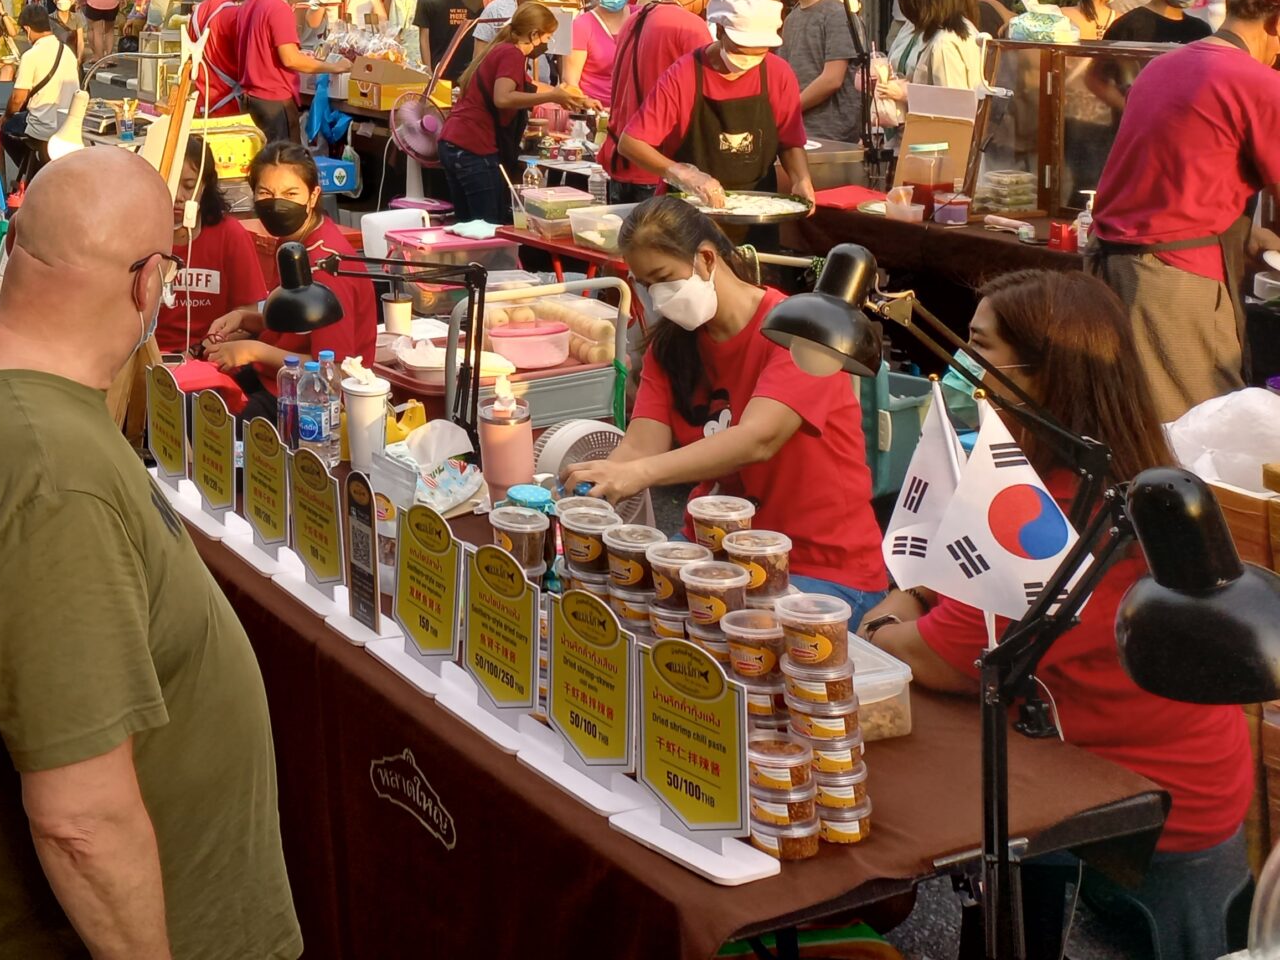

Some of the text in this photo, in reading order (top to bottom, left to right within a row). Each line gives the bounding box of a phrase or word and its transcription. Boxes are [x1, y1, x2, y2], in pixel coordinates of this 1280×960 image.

[180, 299, 211, 307] VODKA
[475, 653, 514, 689] 50/100/250
[563, 655, 577, 671] Dried
[570, 711, 609, 746] 50/100 THB
[652, 712, 727, 754] Dried shrimp chili paste
[666, 770, 715, 808] 50/100 THB
